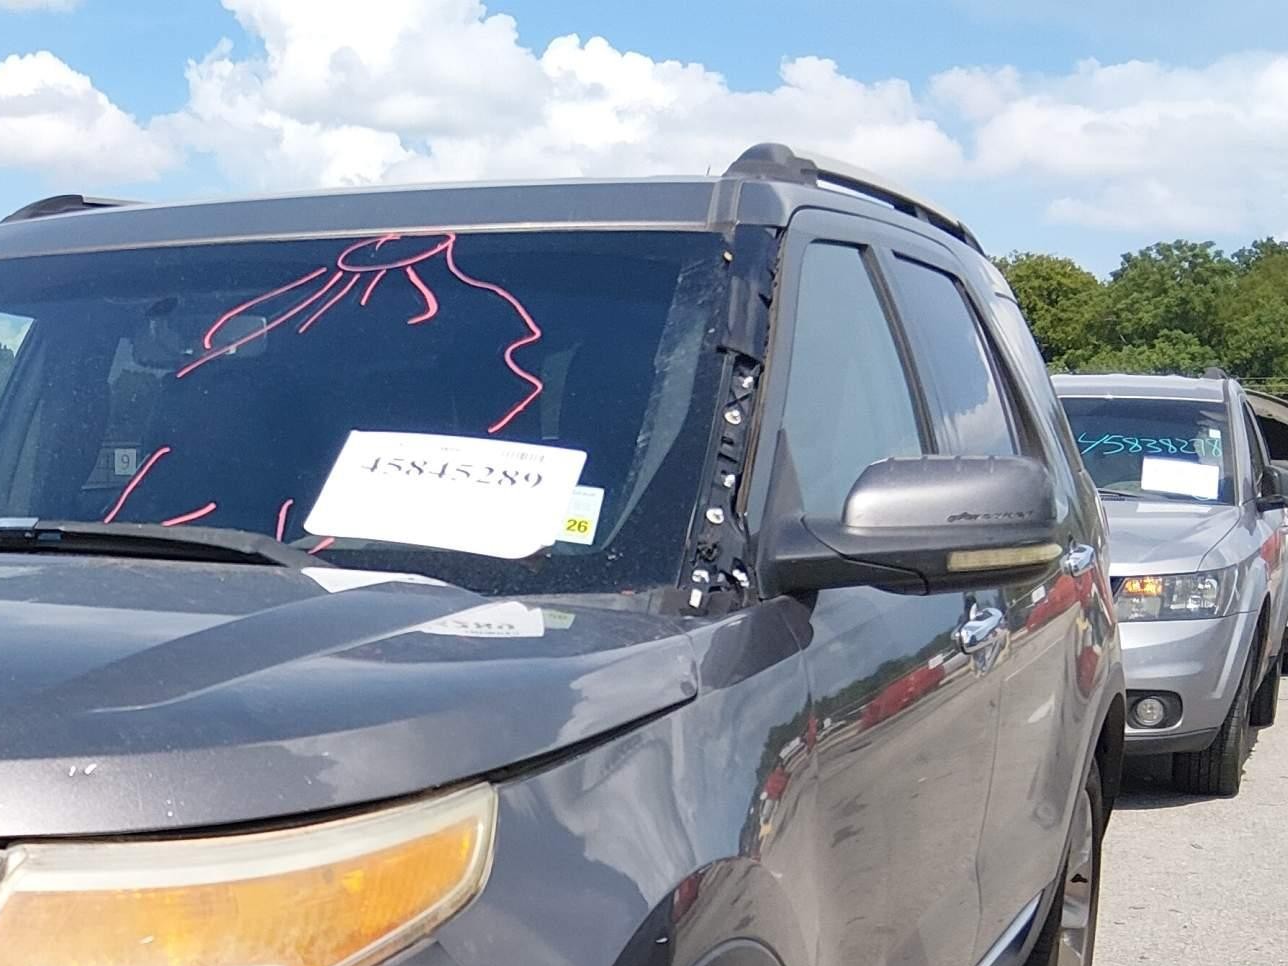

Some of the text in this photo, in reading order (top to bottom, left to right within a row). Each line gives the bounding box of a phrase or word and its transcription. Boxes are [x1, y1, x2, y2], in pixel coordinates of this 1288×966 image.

[121, 454, 130, 471] 9
[361, 456, 544, 488] 45845289
[565, 518, 589, 533] 26
